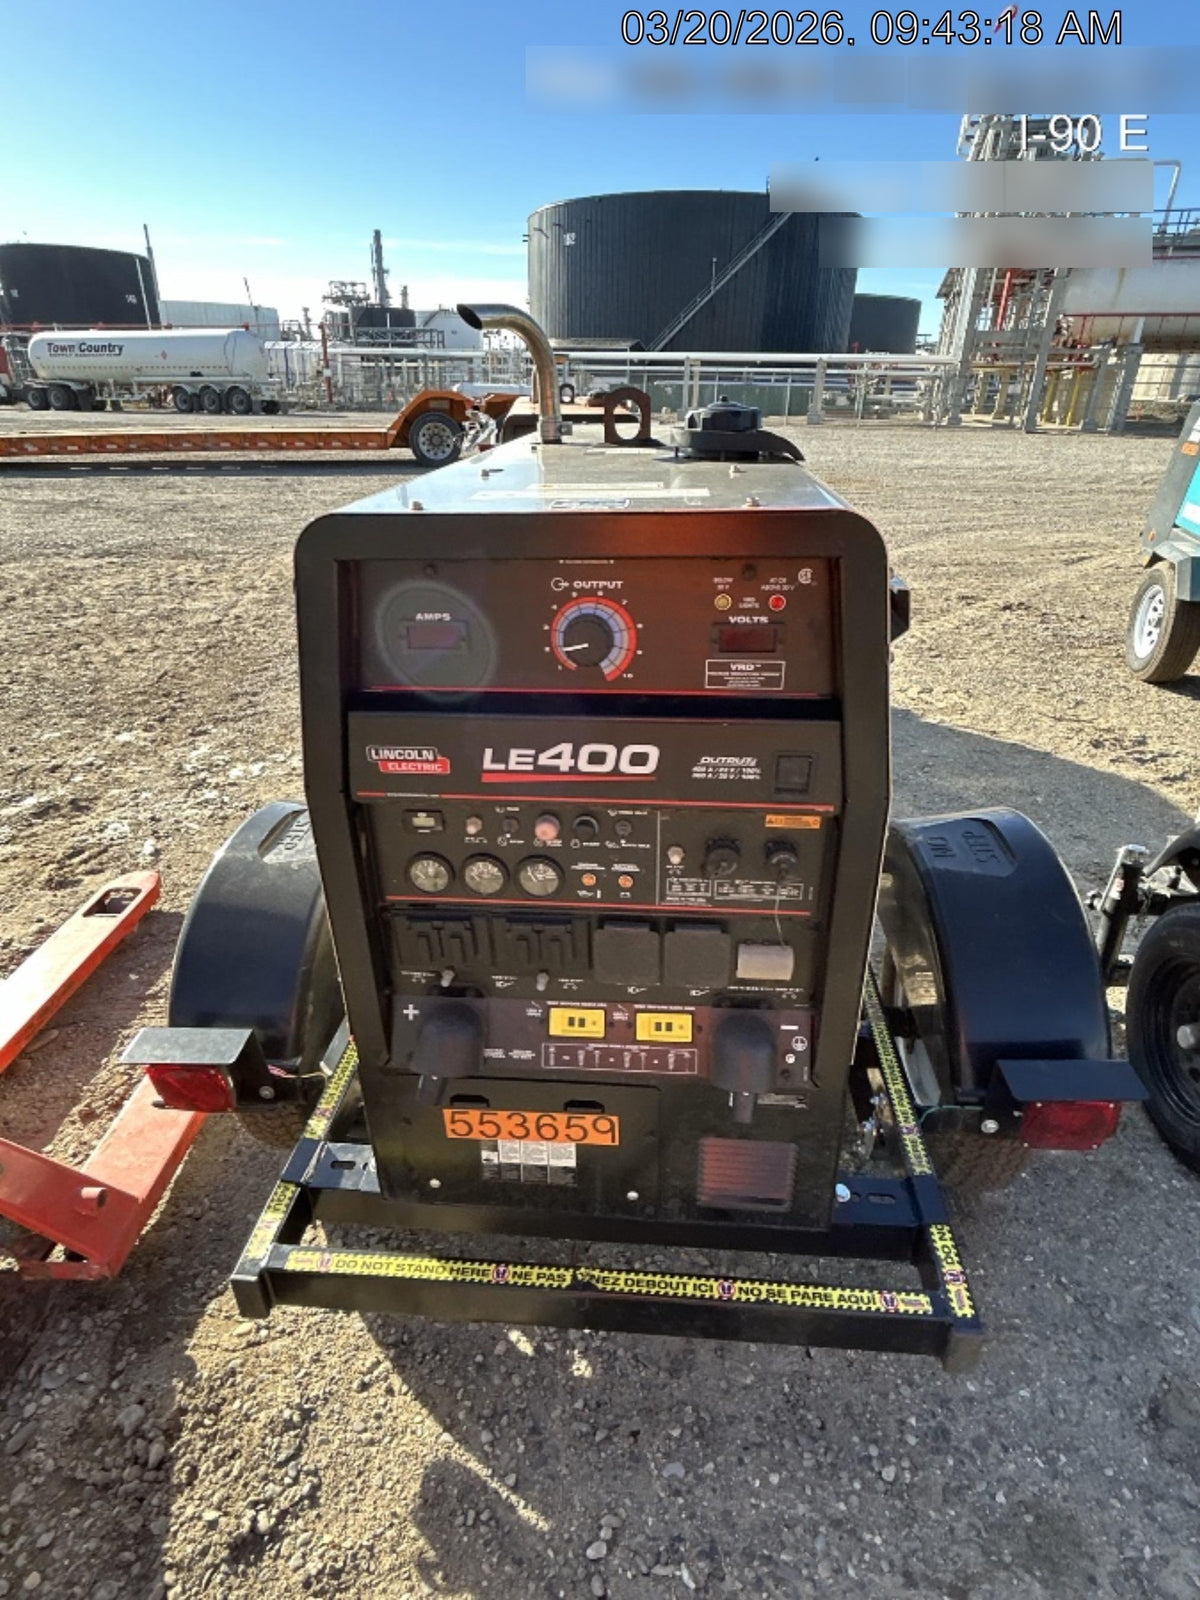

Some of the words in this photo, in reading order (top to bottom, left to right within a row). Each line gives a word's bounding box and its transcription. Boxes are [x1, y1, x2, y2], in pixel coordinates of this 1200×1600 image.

[47, 342, 76, 353] Town
[79, 342, 124, 356] Country
[573, 580, 623, 589] OUTPUT
[416, 612, 450, 621] AMPS
[728, 615, 769, 623] VOLTS
[371, 748, 434, 761] LINCOLN
[482, 742, 660, 775] LE400
[388, 762, 443, 771] ELECTRIC
[450, 1111, 616, 1144] 553659
[335, 1259, 358, 1269] DO
[360, 1260, 392, 1271] NOT
[395, 1262, 447, 1275] STAND
[449, 1266, 491, 1278] HERE
[511, 1270, 532, 1281] NE
[536, 1272, 567, 1283] PAS
[624, 1277, 689, 1292] DEBOUT
[693, 1282, 714, 1293] ICI
[739, 1286, 761, 1297] NO
[766, 1288, 786, 1299] SE
[790, 1290, 833, 1302] PARE
